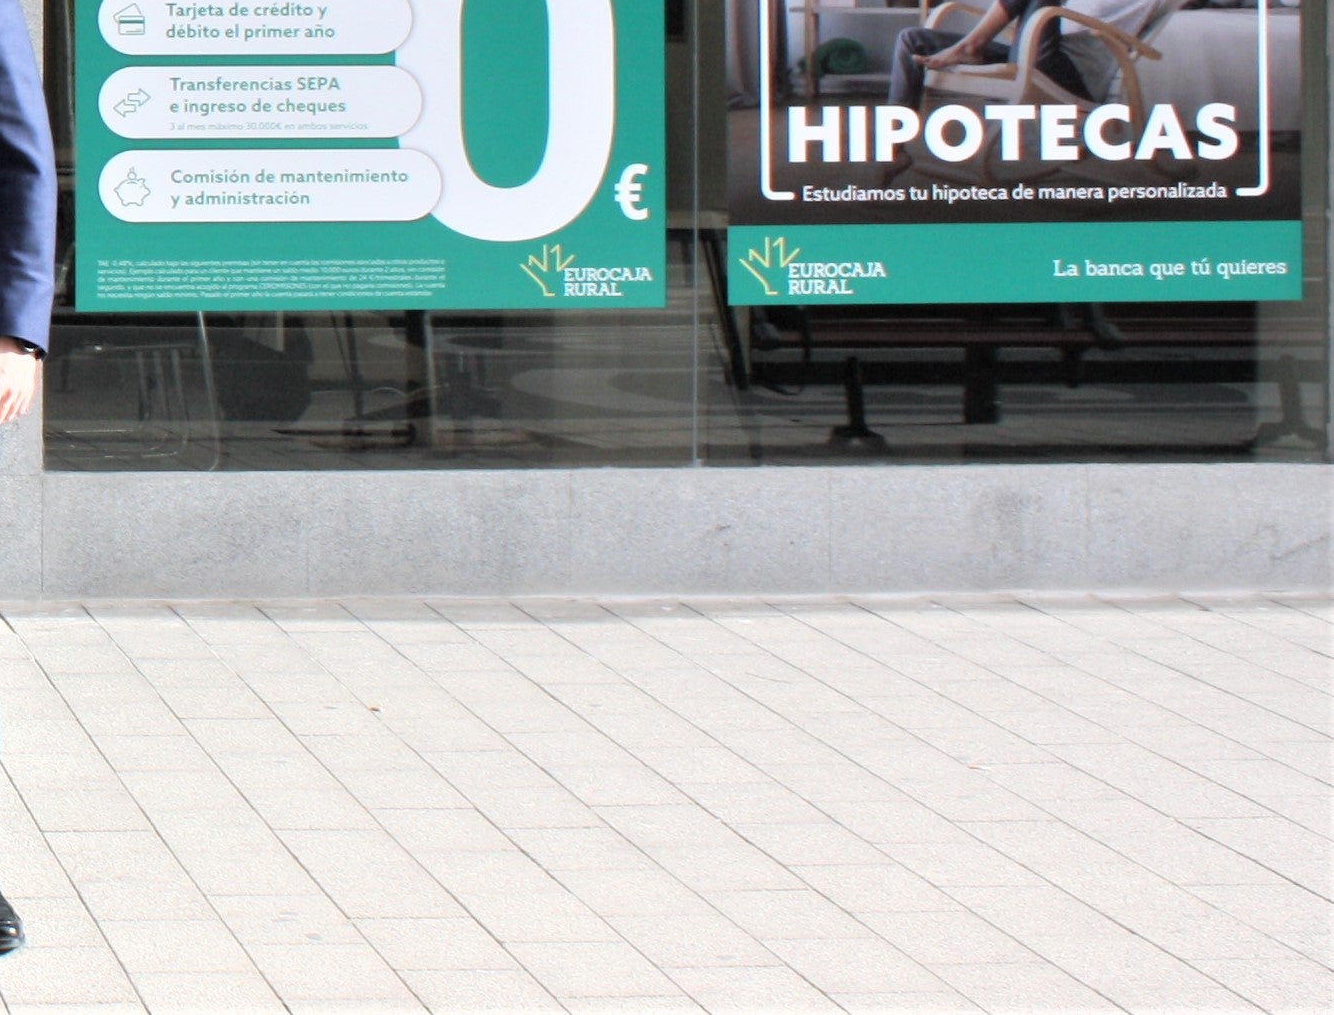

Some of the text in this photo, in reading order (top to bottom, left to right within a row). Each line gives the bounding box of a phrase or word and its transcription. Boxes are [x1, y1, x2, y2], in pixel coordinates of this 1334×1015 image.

[166, 0, 327, 21] Tarjeta de crédito y
[166, 23, 335, 42] débito el primer año
[169, 76, 341, 92] Transferencias SEPA
[170, 97, 347, 117] e ingreso de cheques
[788, 102, 1239, 163] HIPOTECAS
[171, 169, 409, 185] Comisión de mantenimiento
[171, 190, 310, 209] y administración
[614, 162, 649, 221] €
[803, 182, 1227, 204] Estudiamos tu hipoteca de manera personalizada
[564, 267, 652, 282] EUROCAJA
[788, 261, 886, 278] EUROCAJA
[1052, 257, 1287, 281] La banca que tú quieres
[564, 282, 622, 297] RURAL
[788, 279, 853, 295] RURAL
